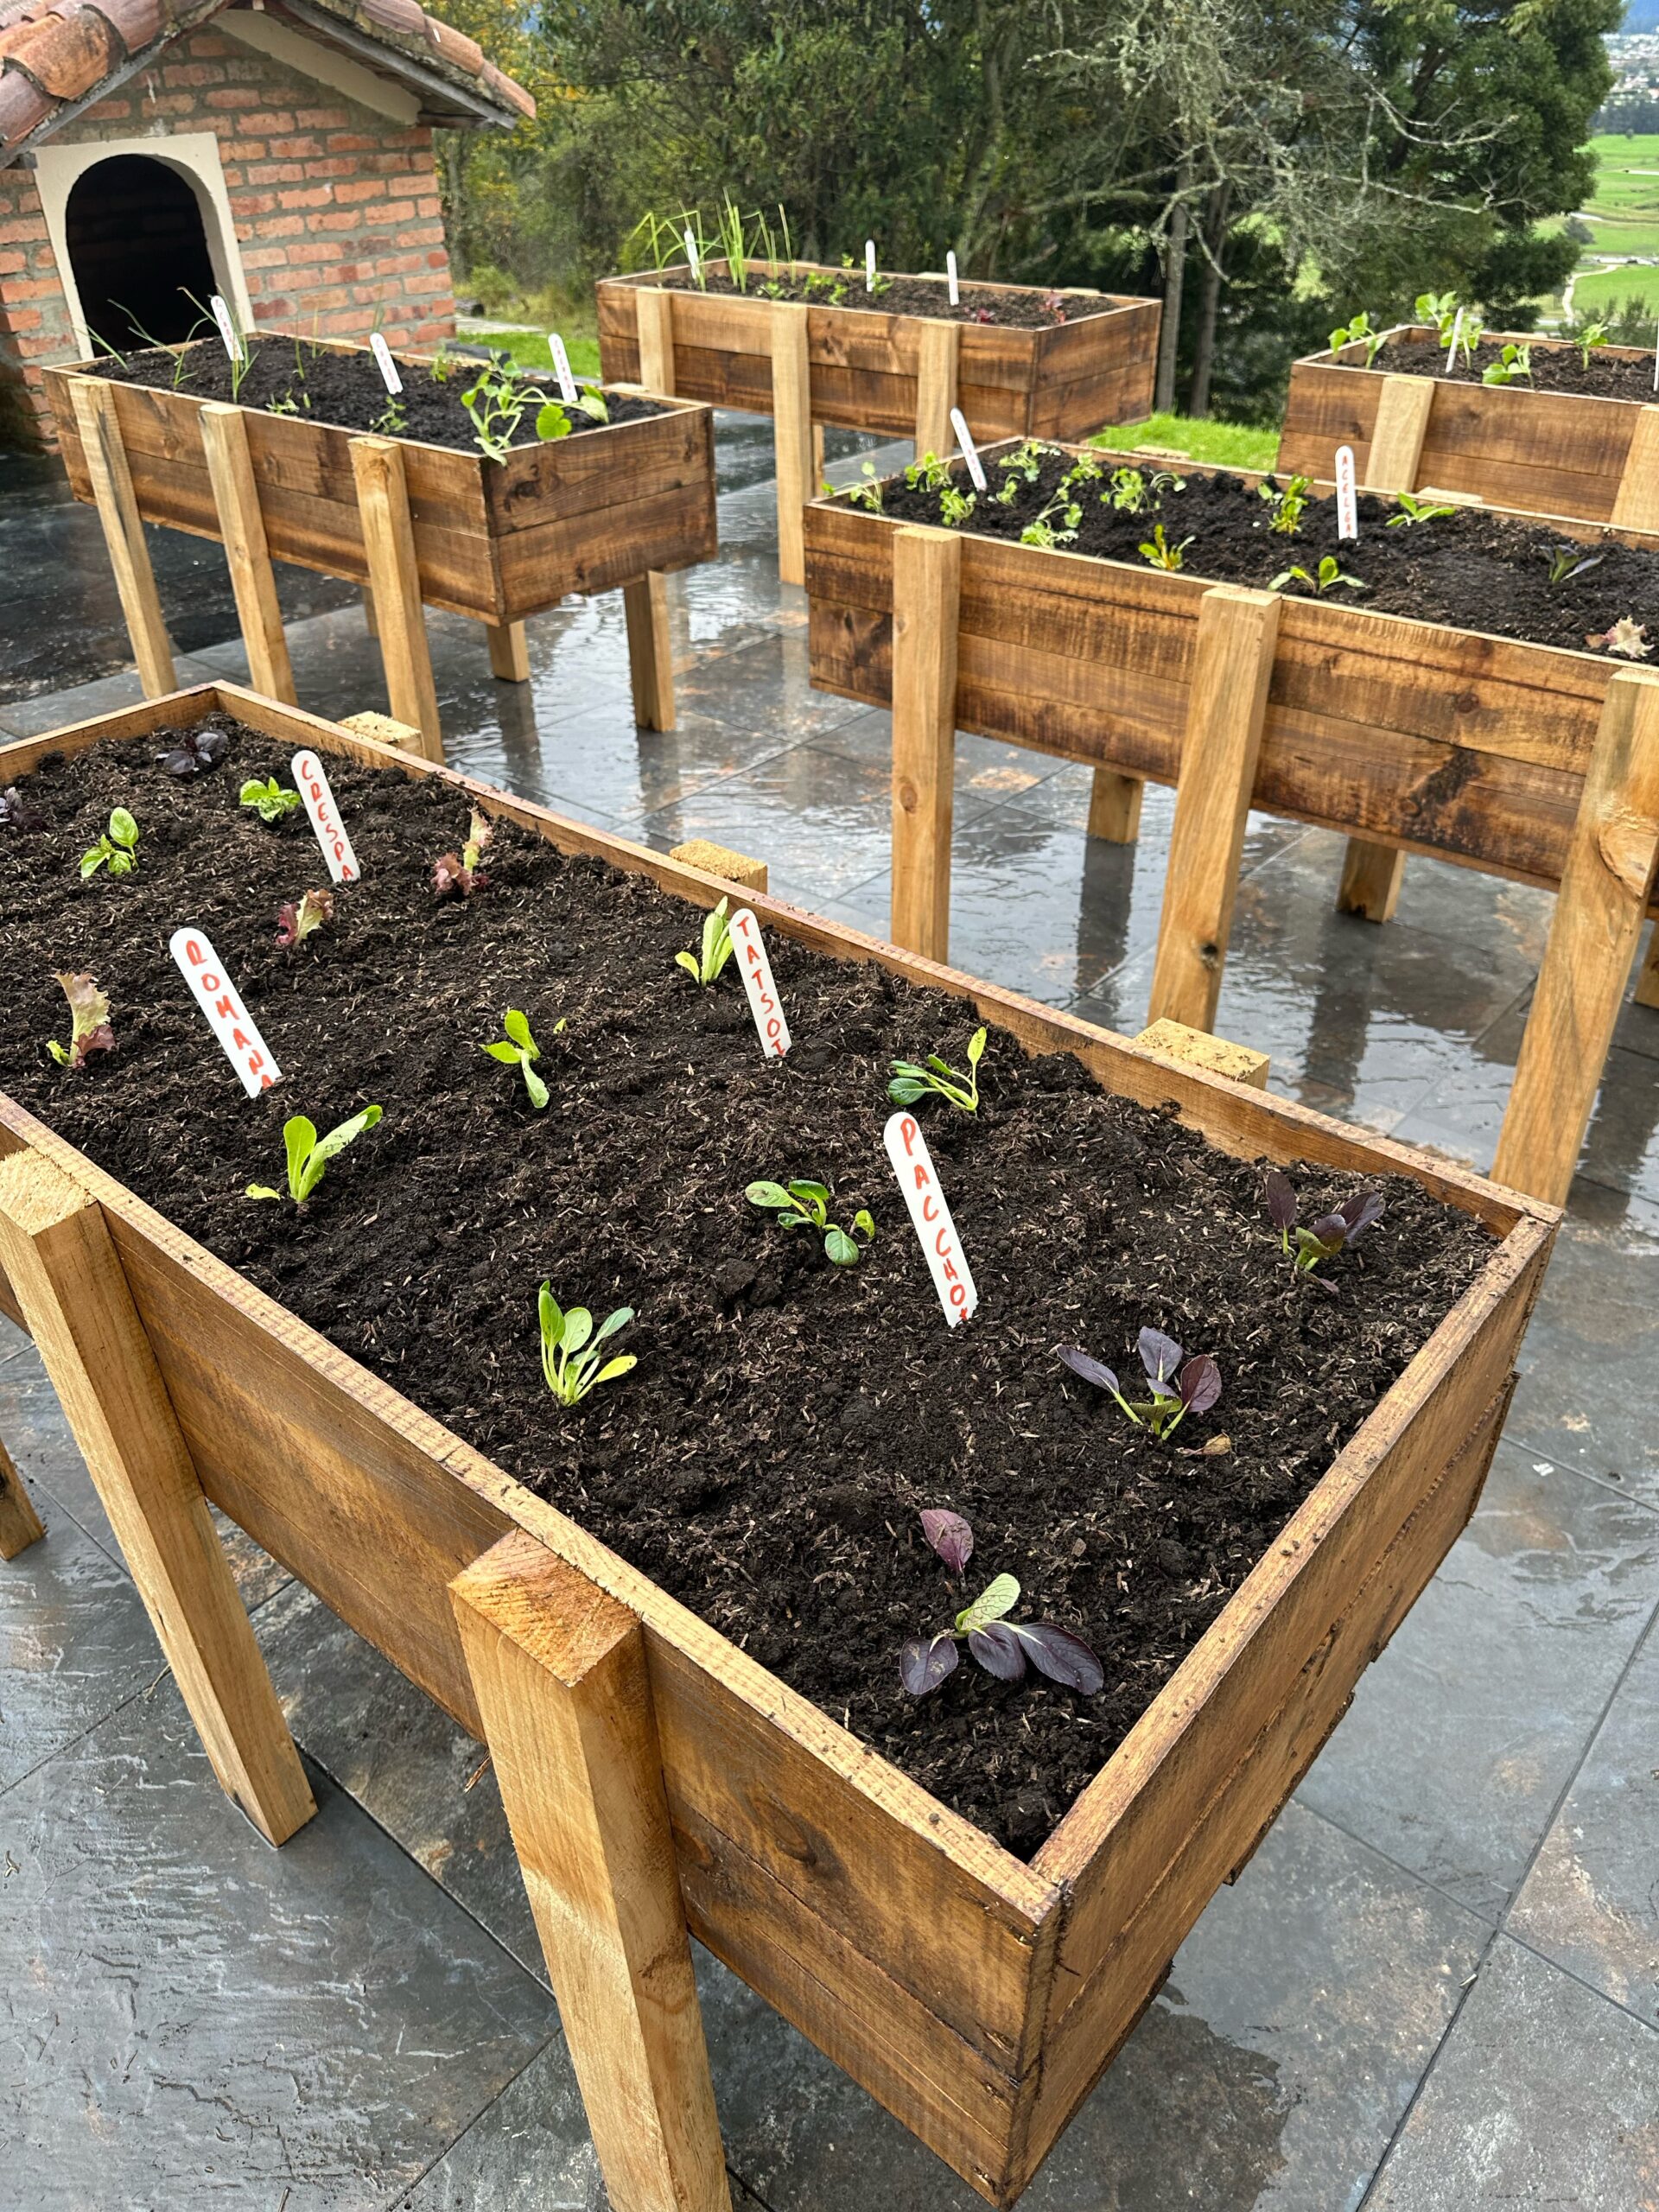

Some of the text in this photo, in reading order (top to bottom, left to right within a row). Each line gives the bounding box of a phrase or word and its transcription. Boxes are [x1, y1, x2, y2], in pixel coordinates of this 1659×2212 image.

[302, 760, 353, 880] CRESPA
[185, 940, 274, 1090] ROMANA
[736, 916, 786, 1056] TATSOI
